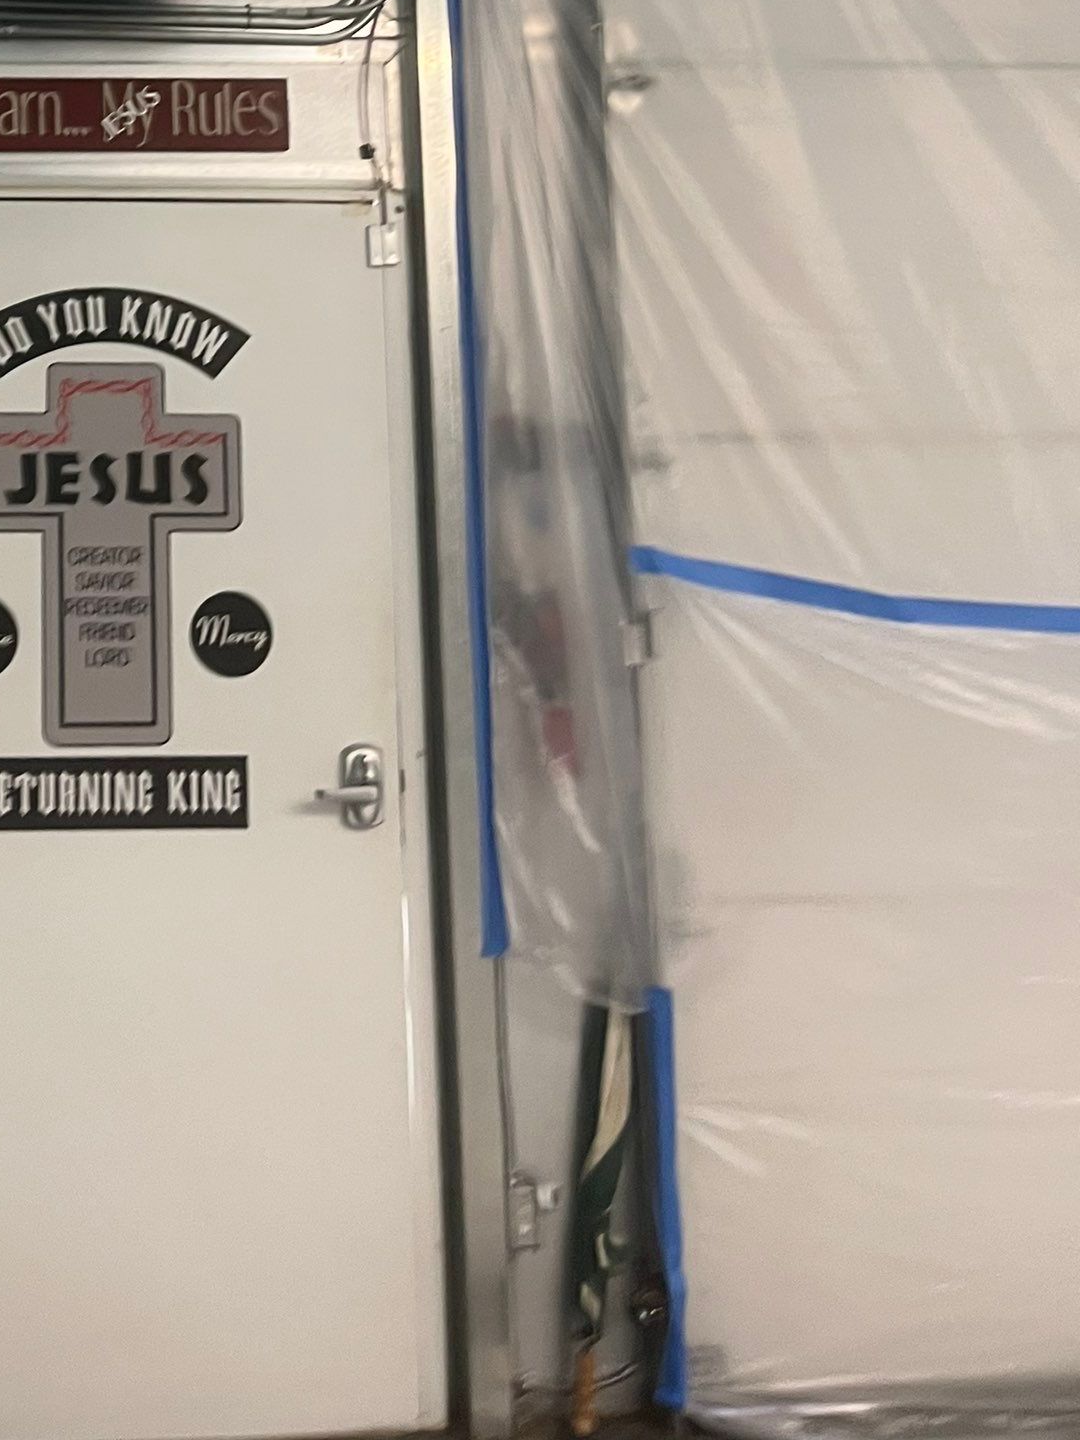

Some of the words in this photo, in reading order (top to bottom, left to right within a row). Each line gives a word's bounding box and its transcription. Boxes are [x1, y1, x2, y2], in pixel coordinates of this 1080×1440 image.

[171, 81, 280, 137] Rules
[35, 294, 109, 344] YOU
[120, 295, 230, 366] KNOW
[3, 451, 209, 506] JESUS
[85, 647, 131, 667] LORD
[195, 613, 269, 652] Mercy
[166, 768, 242, 816] KING
